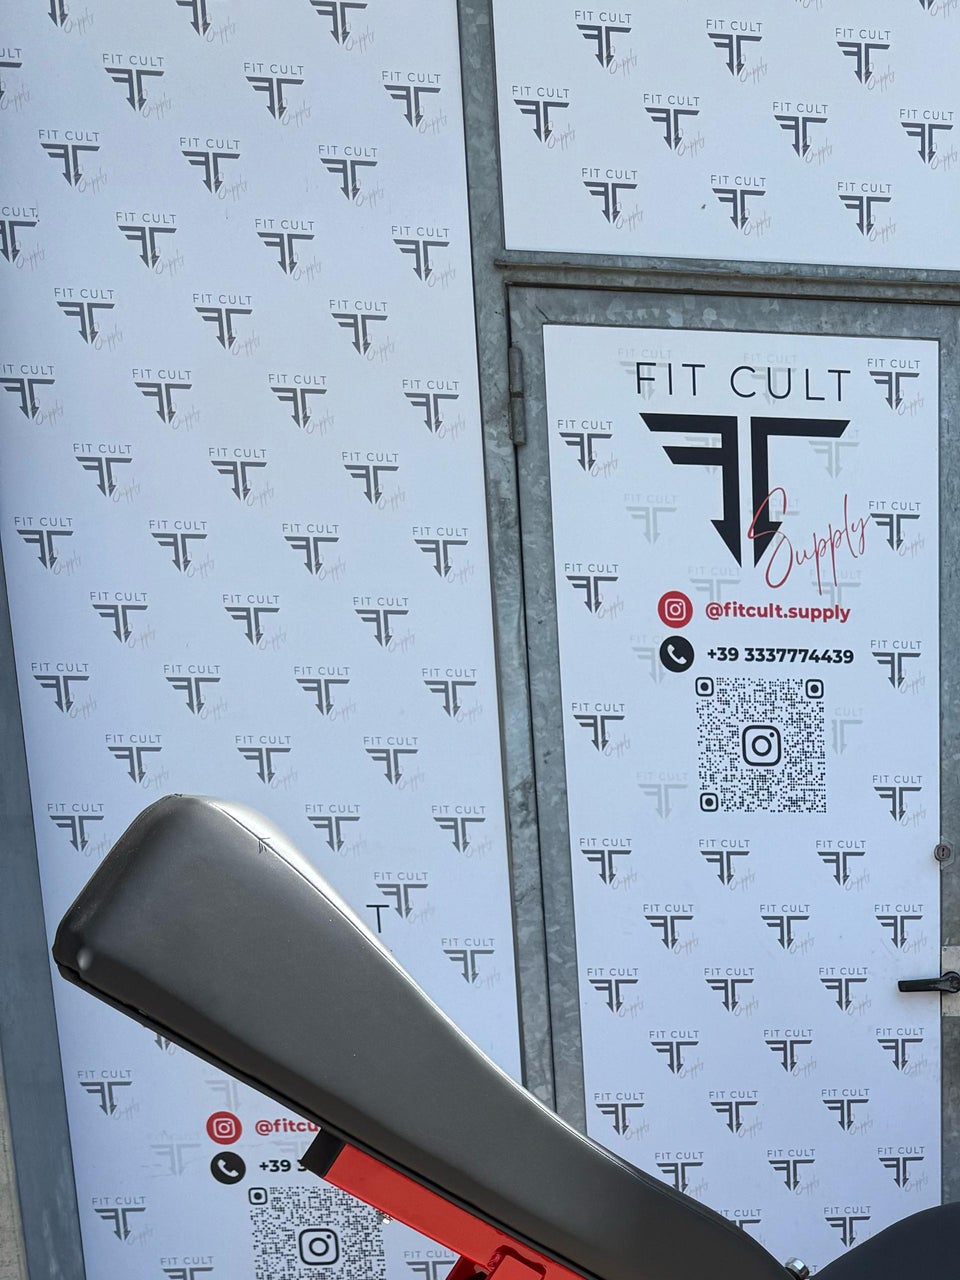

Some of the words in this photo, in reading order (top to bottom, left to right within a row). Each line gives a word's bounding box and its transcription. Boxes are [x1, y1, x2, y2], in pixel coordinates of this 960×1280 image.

[511, 85, 532, 96] FIT
[536, 86, 570, 99] CULT
[643, 93, 663, 105] FIT
[667, 94, 700, 107] CULT
[772, 101, 792, 112] FIT
[796, 102, 829, 114] CULT
[899, 108, 918, 120] FIT
[922, 109, 955, 121] CULT
[38, 128, 59, 140] FIT
[64, 130, 100, 142] CULT
[179, 136, 200, 148] FIT
[205, 138, 241, 150] CULT
[318, 144, 339, 156] FIT
[343, 146, 378, 158] CULT
[391, 225, 411, 236] FIT
[416, 226, 450, 238] CULT
[53, 287, 74, 298] FIT
[79, 288, 115, 300] CULT
[192, 293, 213, 304] FIT
[218, 294, 253, 306] CULT
[867, 357, 886, 368] FIT
[889, 358, 921, 370] CULT
[402, 379, 422, 390] FIT
[426, 380, 460, 391] CULT
[636, 361, 706, 396] FIT
[730, 365, 851, 402] CULT
[557, 419, 577, 429] FIT
[580, 420, 613, 431] CULT
[72, 442, 93, 454] FIT
[98, 443, 132, 455] CULT
[208, 447, 228, 457] FIT
[233, 447, 267, 459] CULT
[868, 500, 887, 511] FIT
[890, 501, 922, 512] CULT
[281, 523, 302, 533] FIT
[306, 523, 340, 534] CULT
[412, 526, 431, 536] FIT
[436, 526, 469, 537] CULT
[747, 487, 871, 596] Supply
[564, 562, 583, 573] FIT
[587, 563, 619, 574] CULT
[705, 601, 851, 624] @fitcult.supply
[870, 639, 888, 649] FIT
[892, 640, 922, 650] CULT
[707, 647, 739, 662] +39
[744, 647, 854, 664] 3337774439
[30, 661, 51, 672] FIT
[55, 662, 89, 673] CULT
[163, 664, 183, 674] FIT
[187, 664, 221, 675] CULT
[293, 665, 313, 676] FIT
[317, 666, 350, 676] CULT
[421, 667, 441, 677] FIT
[445, 668, 477, 678] CULT
[571, 702, 590, 712] FIT
[594, 702, 626, 713] CULT
[872, 774, 890, 784] FIT
[893, 775, 923, 784] CULT
[46, 802, 67, 813] FIT
[71, 803, 105, 813] CULT
[373, 871, 393, 881] FIT
[397, 871, 429, 881] CULT
[642, 903, 661, 913] FIT
[664, 903, 694, 913] CULT
[874, 904, 891, 913] FIT
[895, 904, 924, 913] CULT
[76, 1070, 96, 1079] FIT
[100, 1069, 131, 1079] CULT
[593, 1092, 612, 1101] FIT
[615, 1092, 645, 1101] CULT
[821, 1088, 838, 1097] FIT
[841, 1088, 870, 1097] CULT
[259, 1159, 292, 1173] +39
[91, 1196, 110, 1206] FIT
[114, 1196, 146, 1205] CULT
[823, 1206, 840, 1215] FIT
[843, 1205, 871, 1215] CULT
